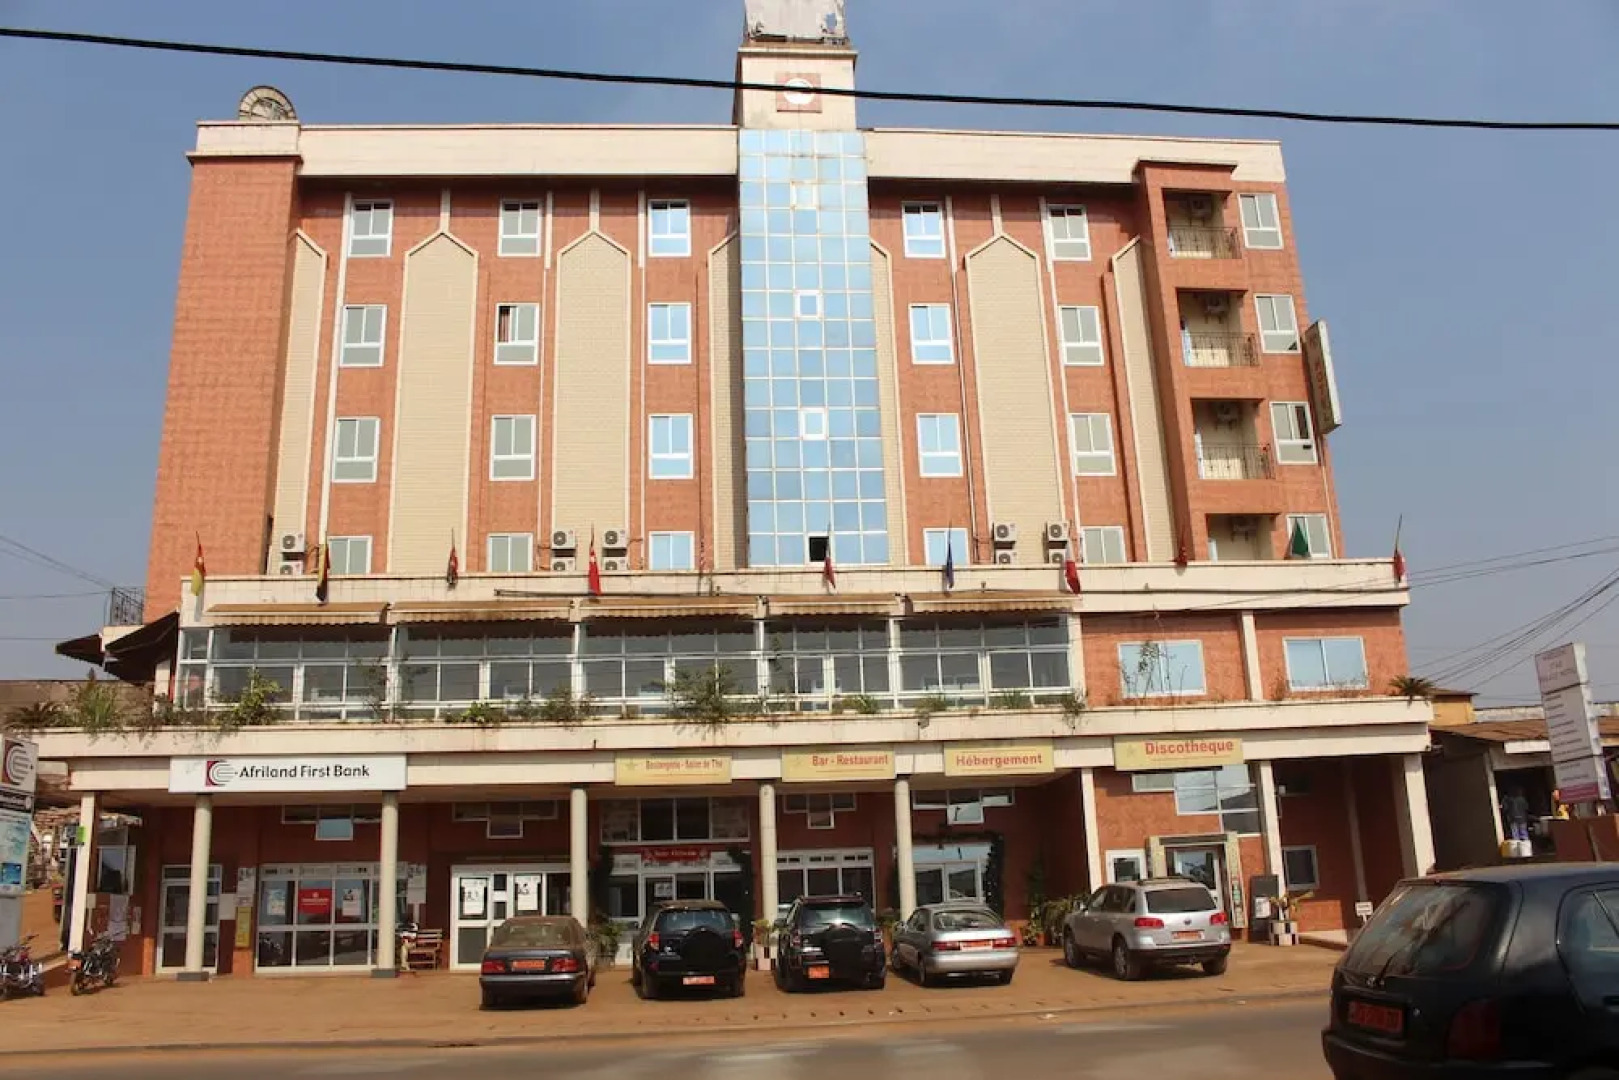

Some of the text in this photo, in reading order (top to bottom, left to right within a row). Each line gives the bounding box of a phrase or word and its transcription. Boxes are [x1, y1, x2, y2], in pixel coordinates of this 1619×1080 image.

[812, 755, 829, 766] Bar
[836, 754, 888, 765] Restaurant
[239, 764, 369, 778] Afriland First Bank
